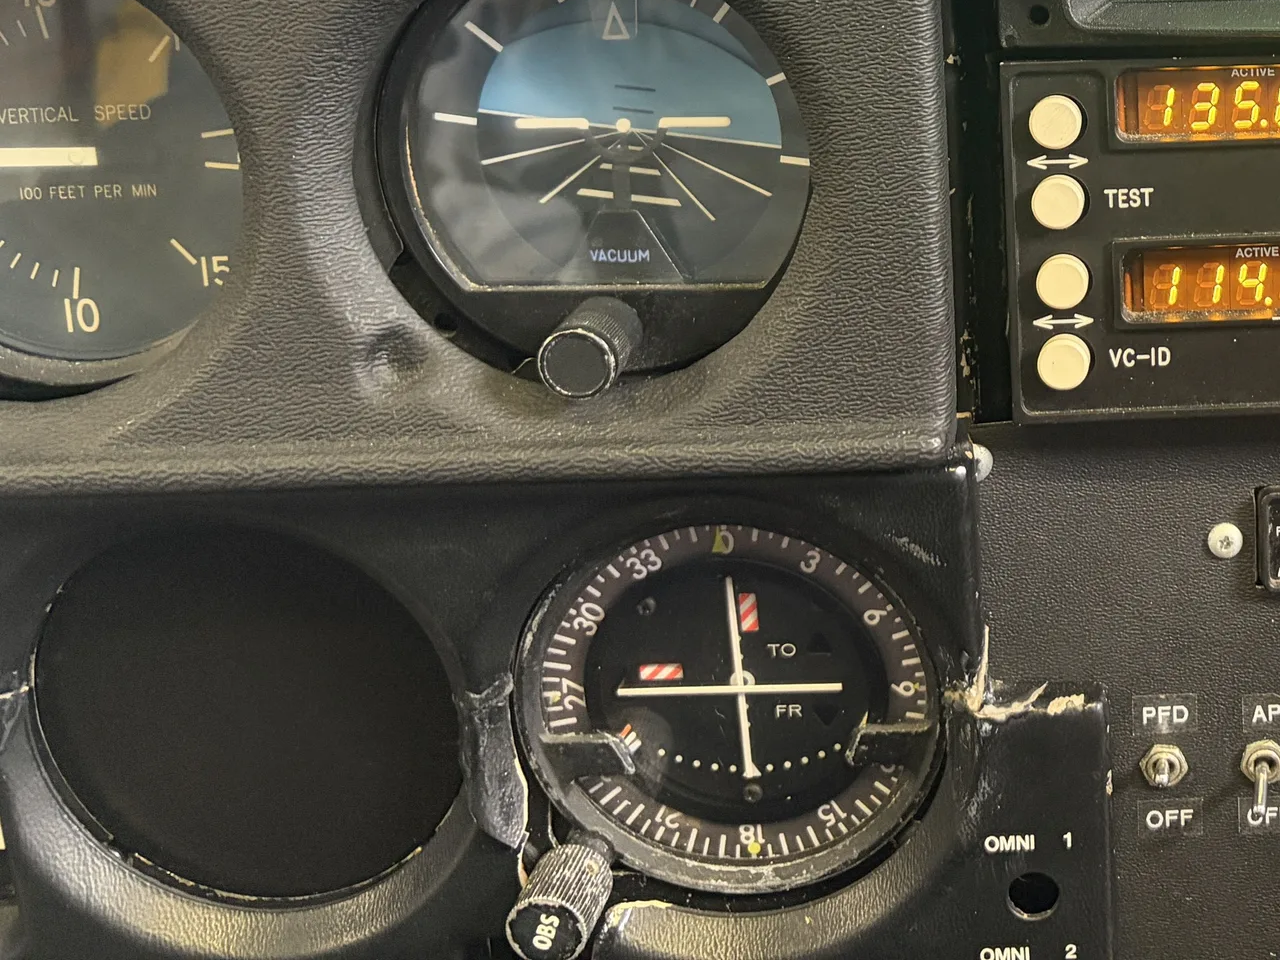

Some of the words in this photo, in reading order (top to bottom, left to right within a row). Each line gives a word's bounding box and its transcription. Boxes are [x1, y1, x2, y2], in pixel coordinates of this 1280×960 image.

[94, 105, 151, 120] SPEED
[19, 187, 42, 199] 100
[50, 186, 84, 199] FEET
[95, 186, 122, 198] PER
[133, 185, 157, 197] MIN
[1104, 188, 1154, 207] TEST
[590, 249, 650, 262] VACUUM
[1236, 247, 1279, 257] ACTIVE
[1109, 348, 1170, 366] VC-ID
[768, 643, 796, 656] TO
[776, 704, 801, 718] FR
[1143, 704, 1189, 725] PFD
[1145, 809, 1194, 827] OFF
[985, 835, 1035, 853] OMNI
[532, 914, 560, 950] OBS
